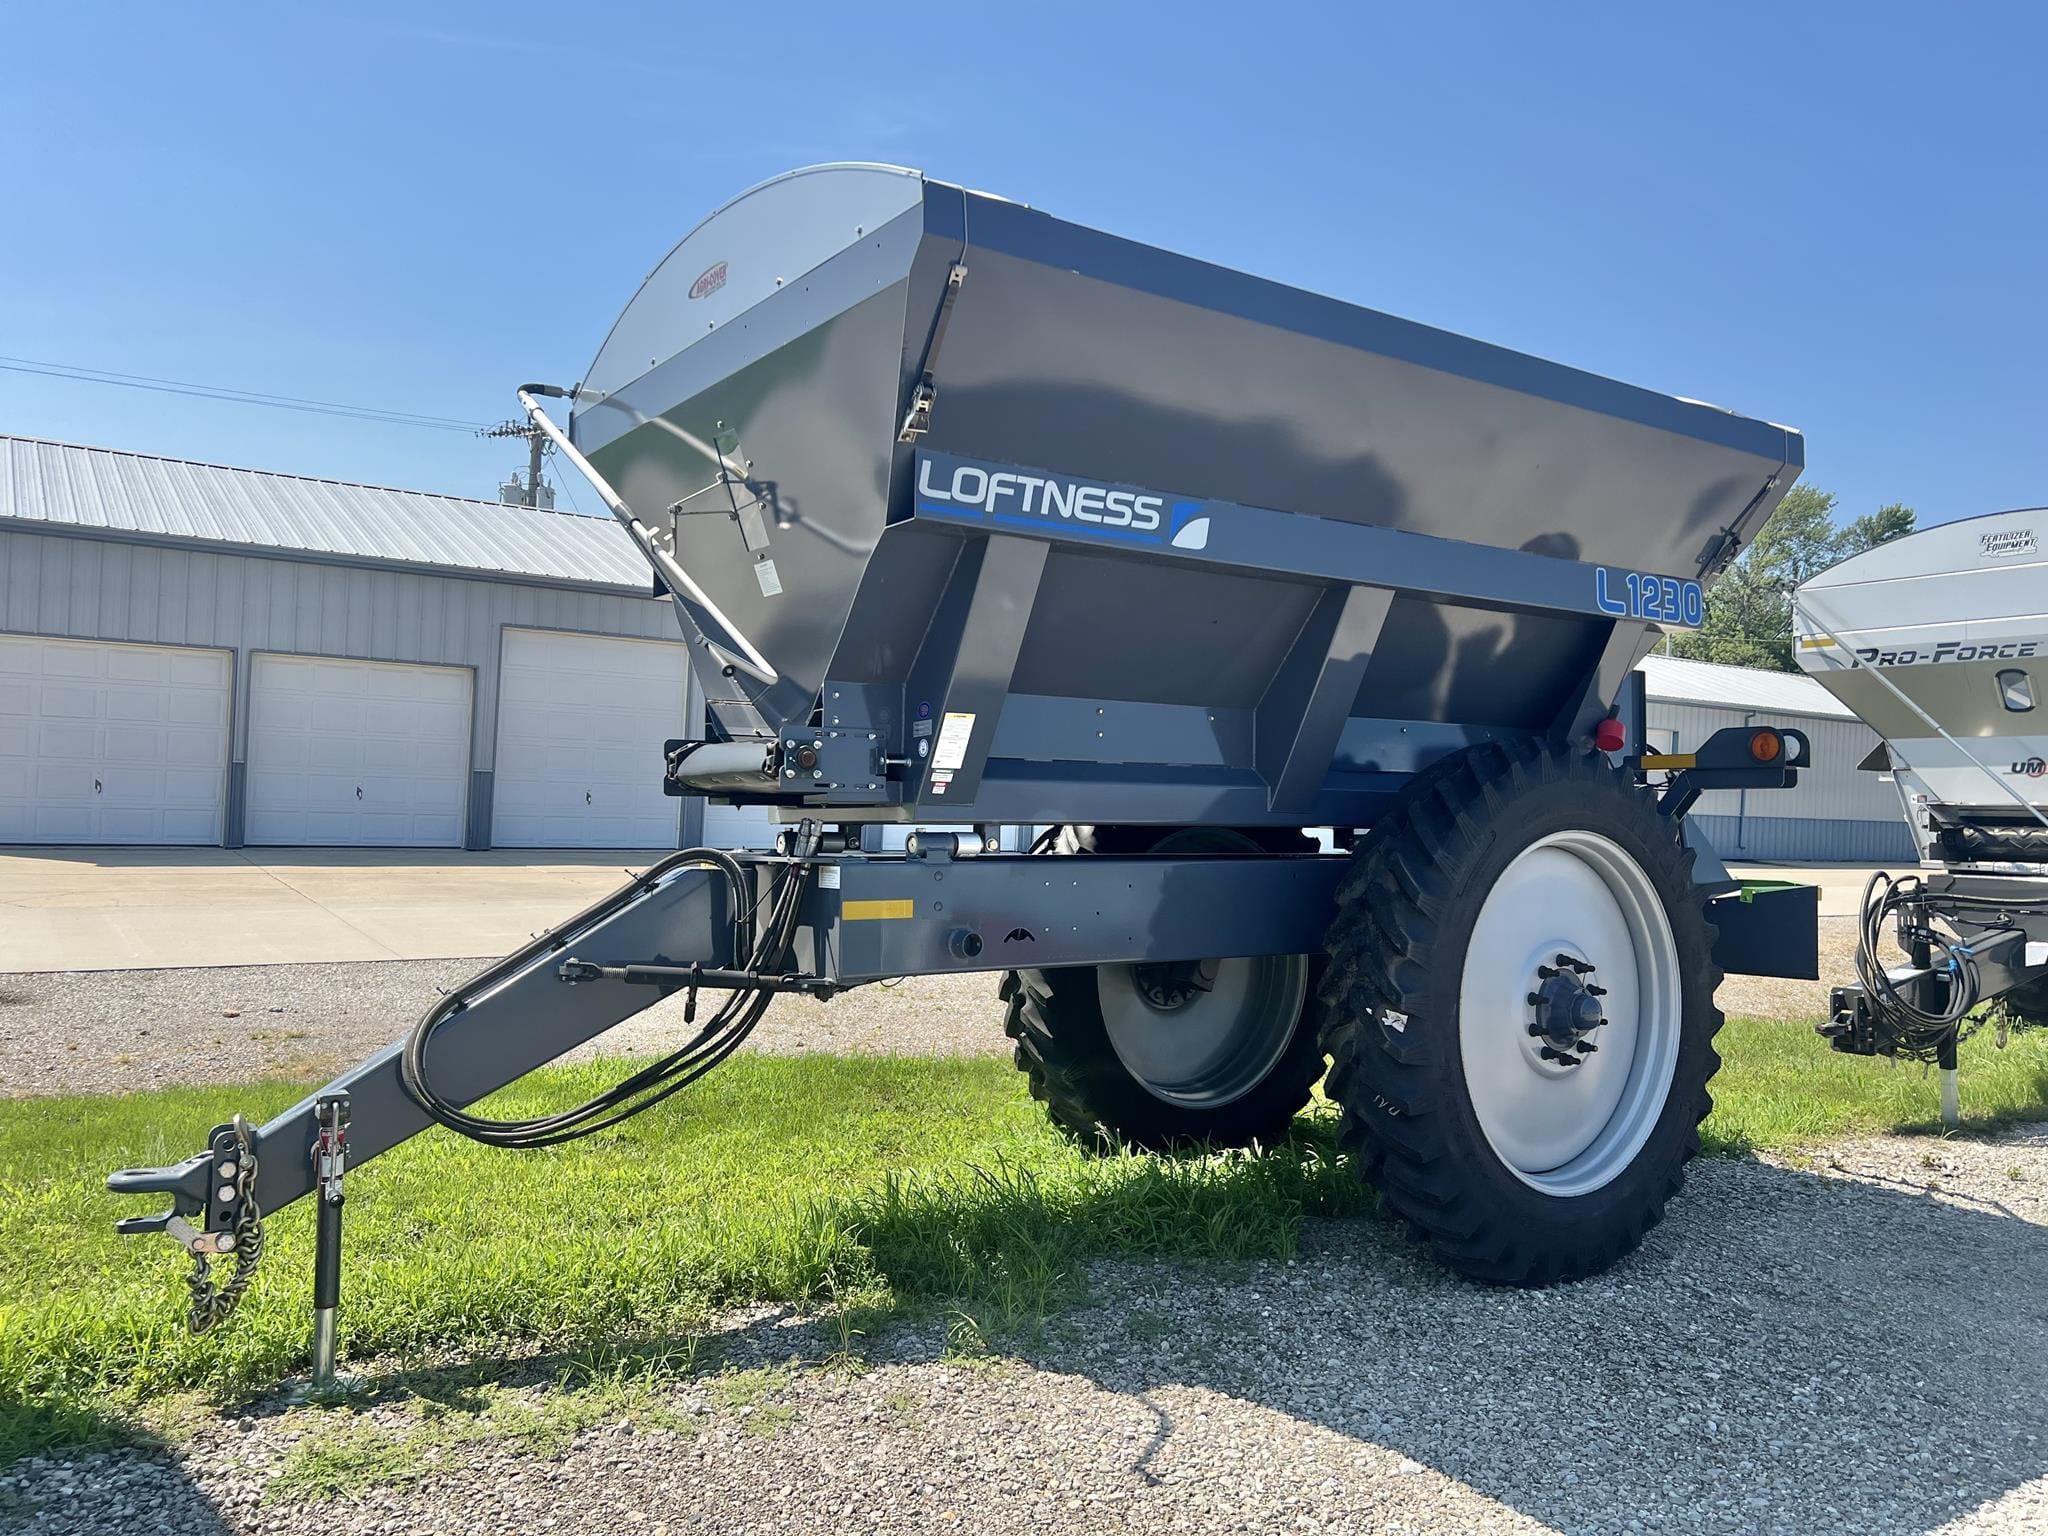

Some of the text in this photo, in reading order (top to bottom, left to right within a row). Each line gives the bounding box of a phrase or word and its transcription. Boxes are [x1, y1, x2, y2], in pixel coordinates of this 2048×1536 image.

[918, 459, 1163, 530] LOFTNESS
[1981, 530, 2031, 543] FERTILIZER
[1986, 538, 2036, 552] EQUIPMENT
[1596, 567, 1703, 626] L1230
